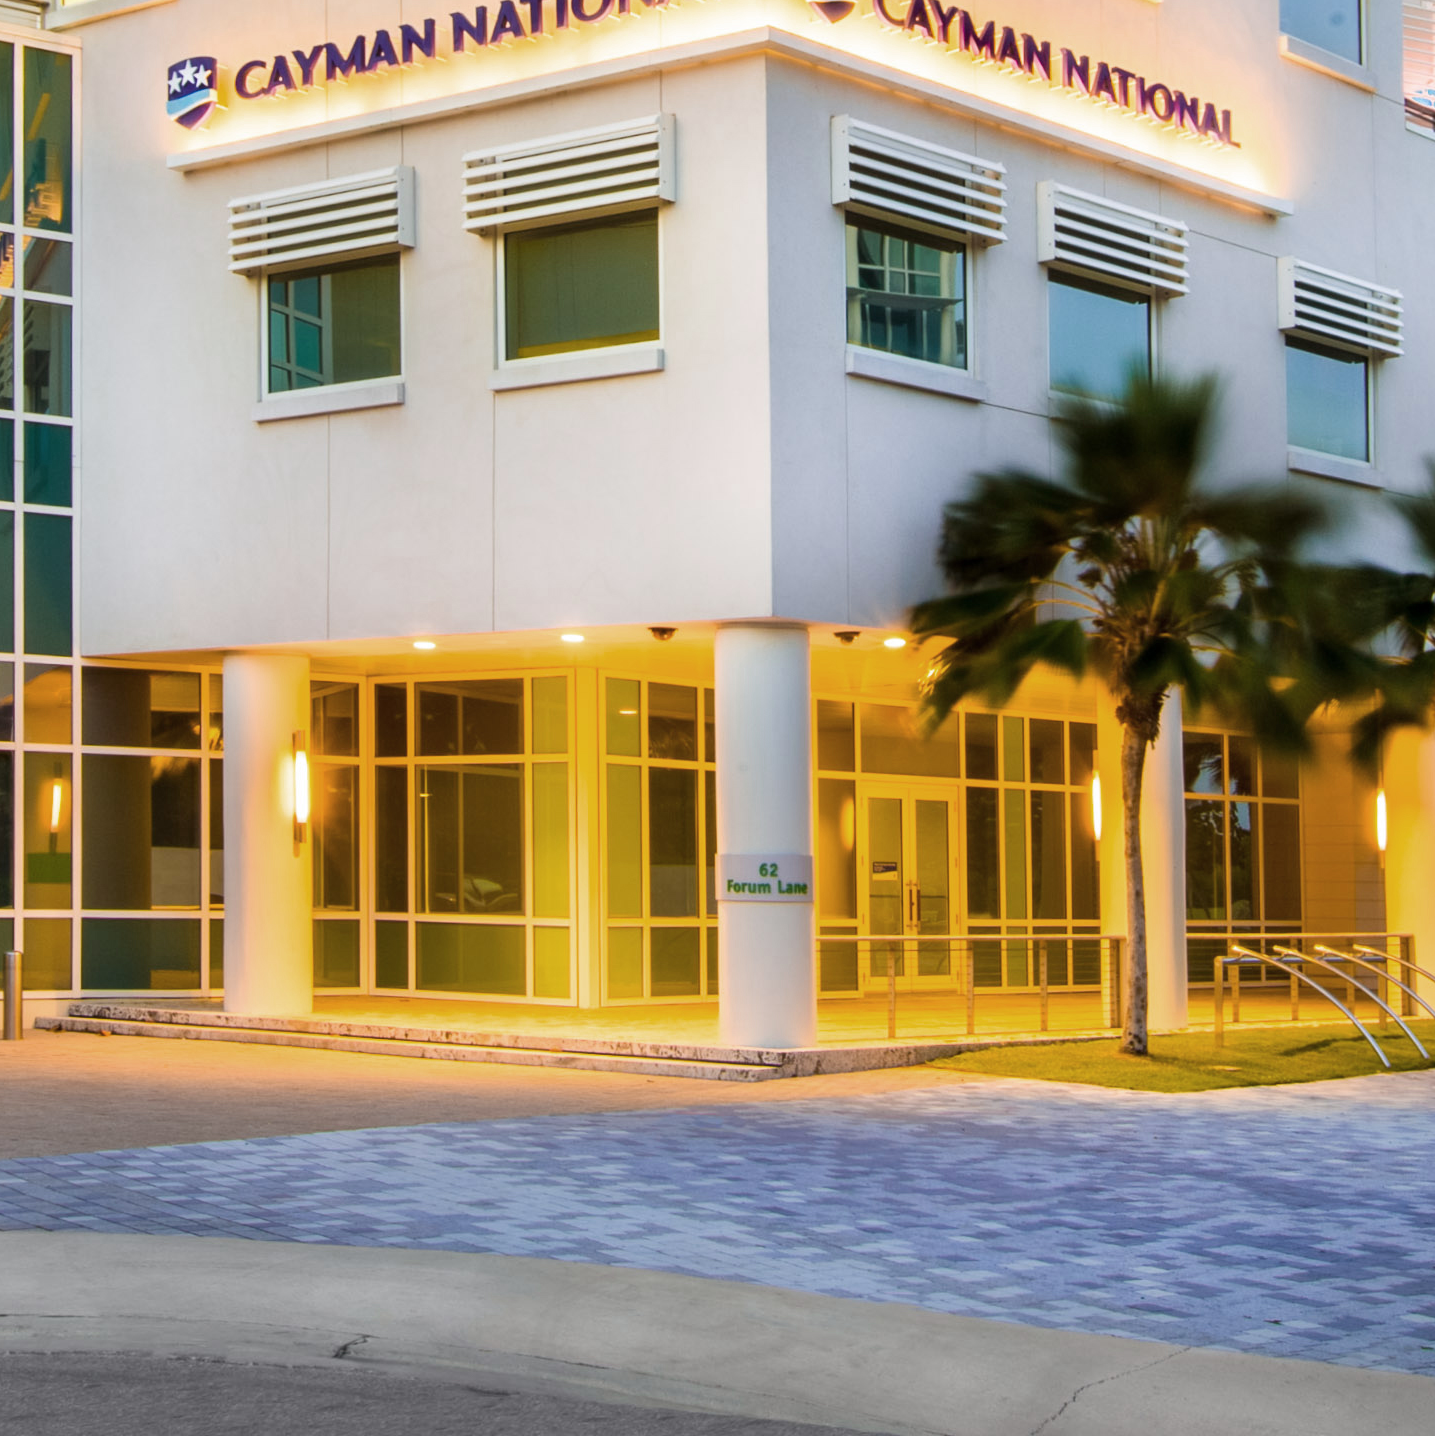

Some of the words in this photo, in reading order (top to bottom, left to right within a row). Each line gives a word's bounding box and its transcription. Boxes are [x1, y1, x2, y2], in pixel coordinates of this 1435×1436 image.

[235, 18, 435, 99] CAYMAN
[1060, 48, 1241, 148] NATIONAL
[727, 879, 771, 893] Forum
[778, 880, 808, 894] Lane
[759, 863, 778, 877] 62
